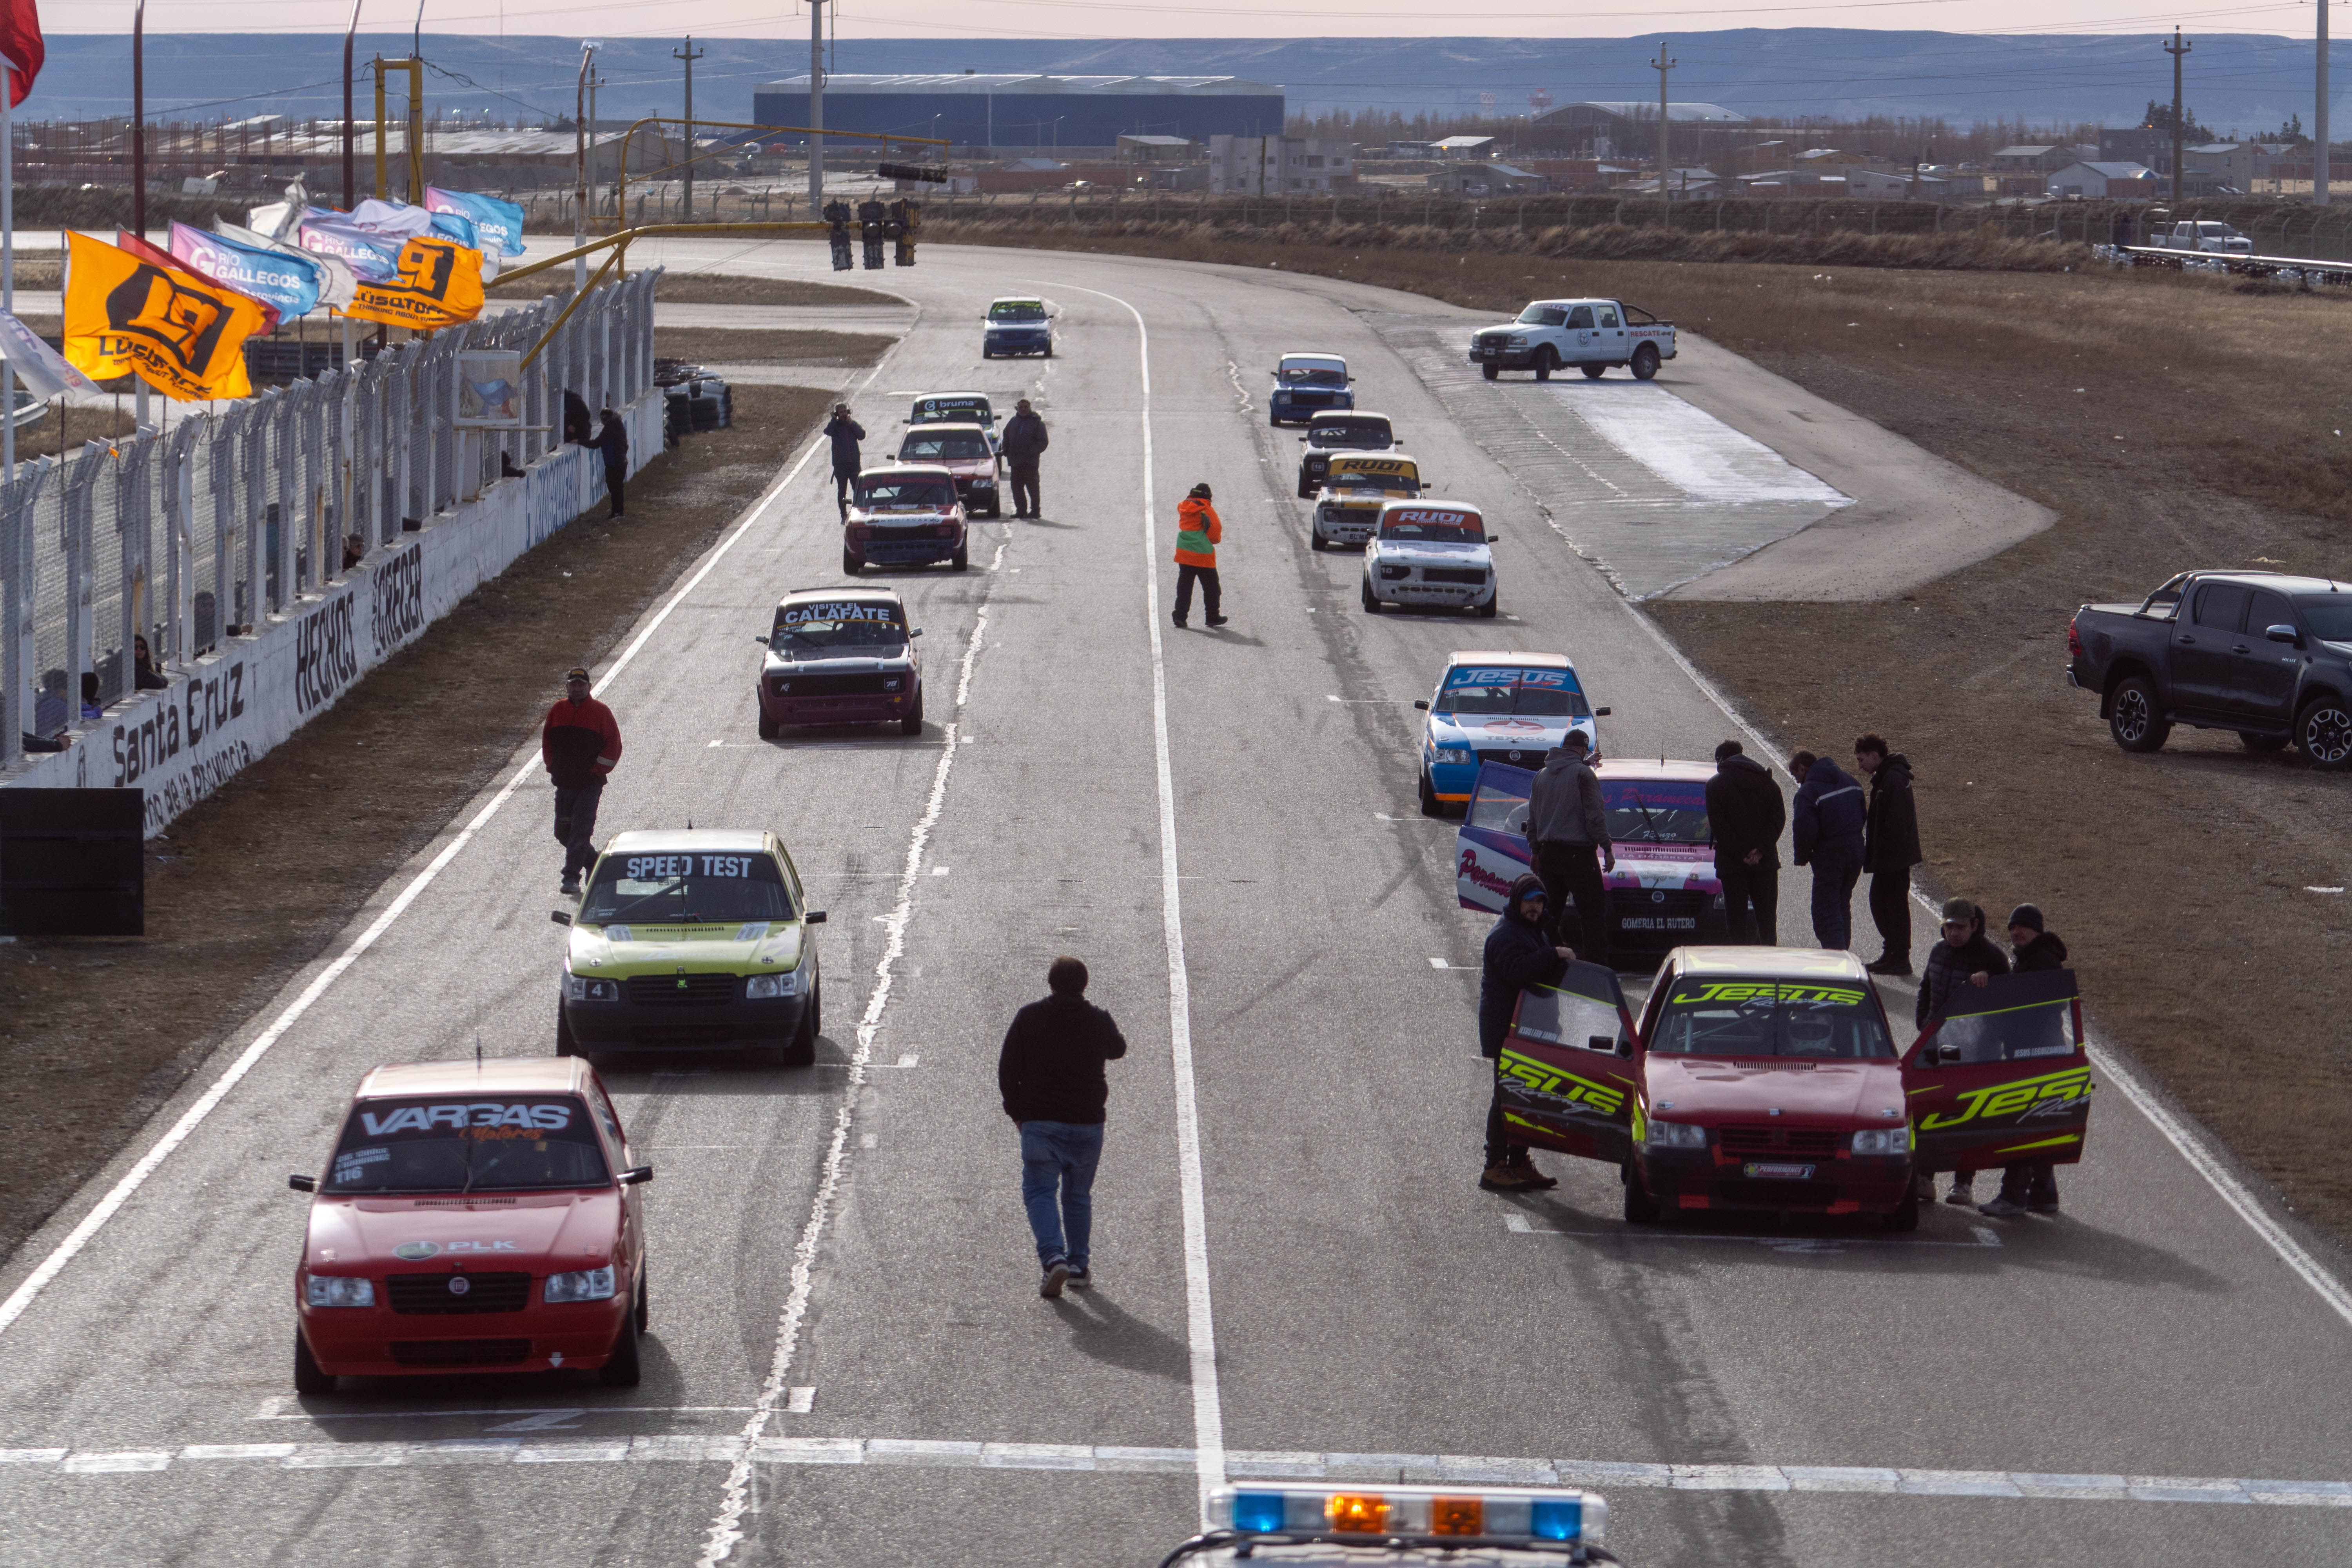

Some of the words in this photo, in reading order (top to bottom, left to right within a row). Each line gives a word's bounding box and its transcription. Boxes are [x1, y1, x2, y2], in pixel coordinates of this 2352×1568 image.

[218, 251, 240, 267] RÍO
[216, 265, 301, 289] GALLEGOS
[358, 303, 394, 315] THINKING
[395, 310, 419, 321] ABOUT
[1342, 461, 1404, 471] RUDI
[1398, 511, 1465, 524] RUDI
[785, 606, 890, 624] CALAFATE
[296, 590, 357, 715] HECHOS
[377, 542, 425, 651] CRECER
[113, 700, 180, 788] Santa
[627, 855, 693, 878] SPEED
[701, 855, 752, 878] TEST
[1622, 917, 1655, 929] GOMERIA
[1656, 917, 1665, 929] EL
[1667, 917, 1695, 929] RUTERO
[591, 984, 603, 996] 4
[361, 1102, 572, 1136] VARGAS
[448, 1240, 517, 1250] PLK
